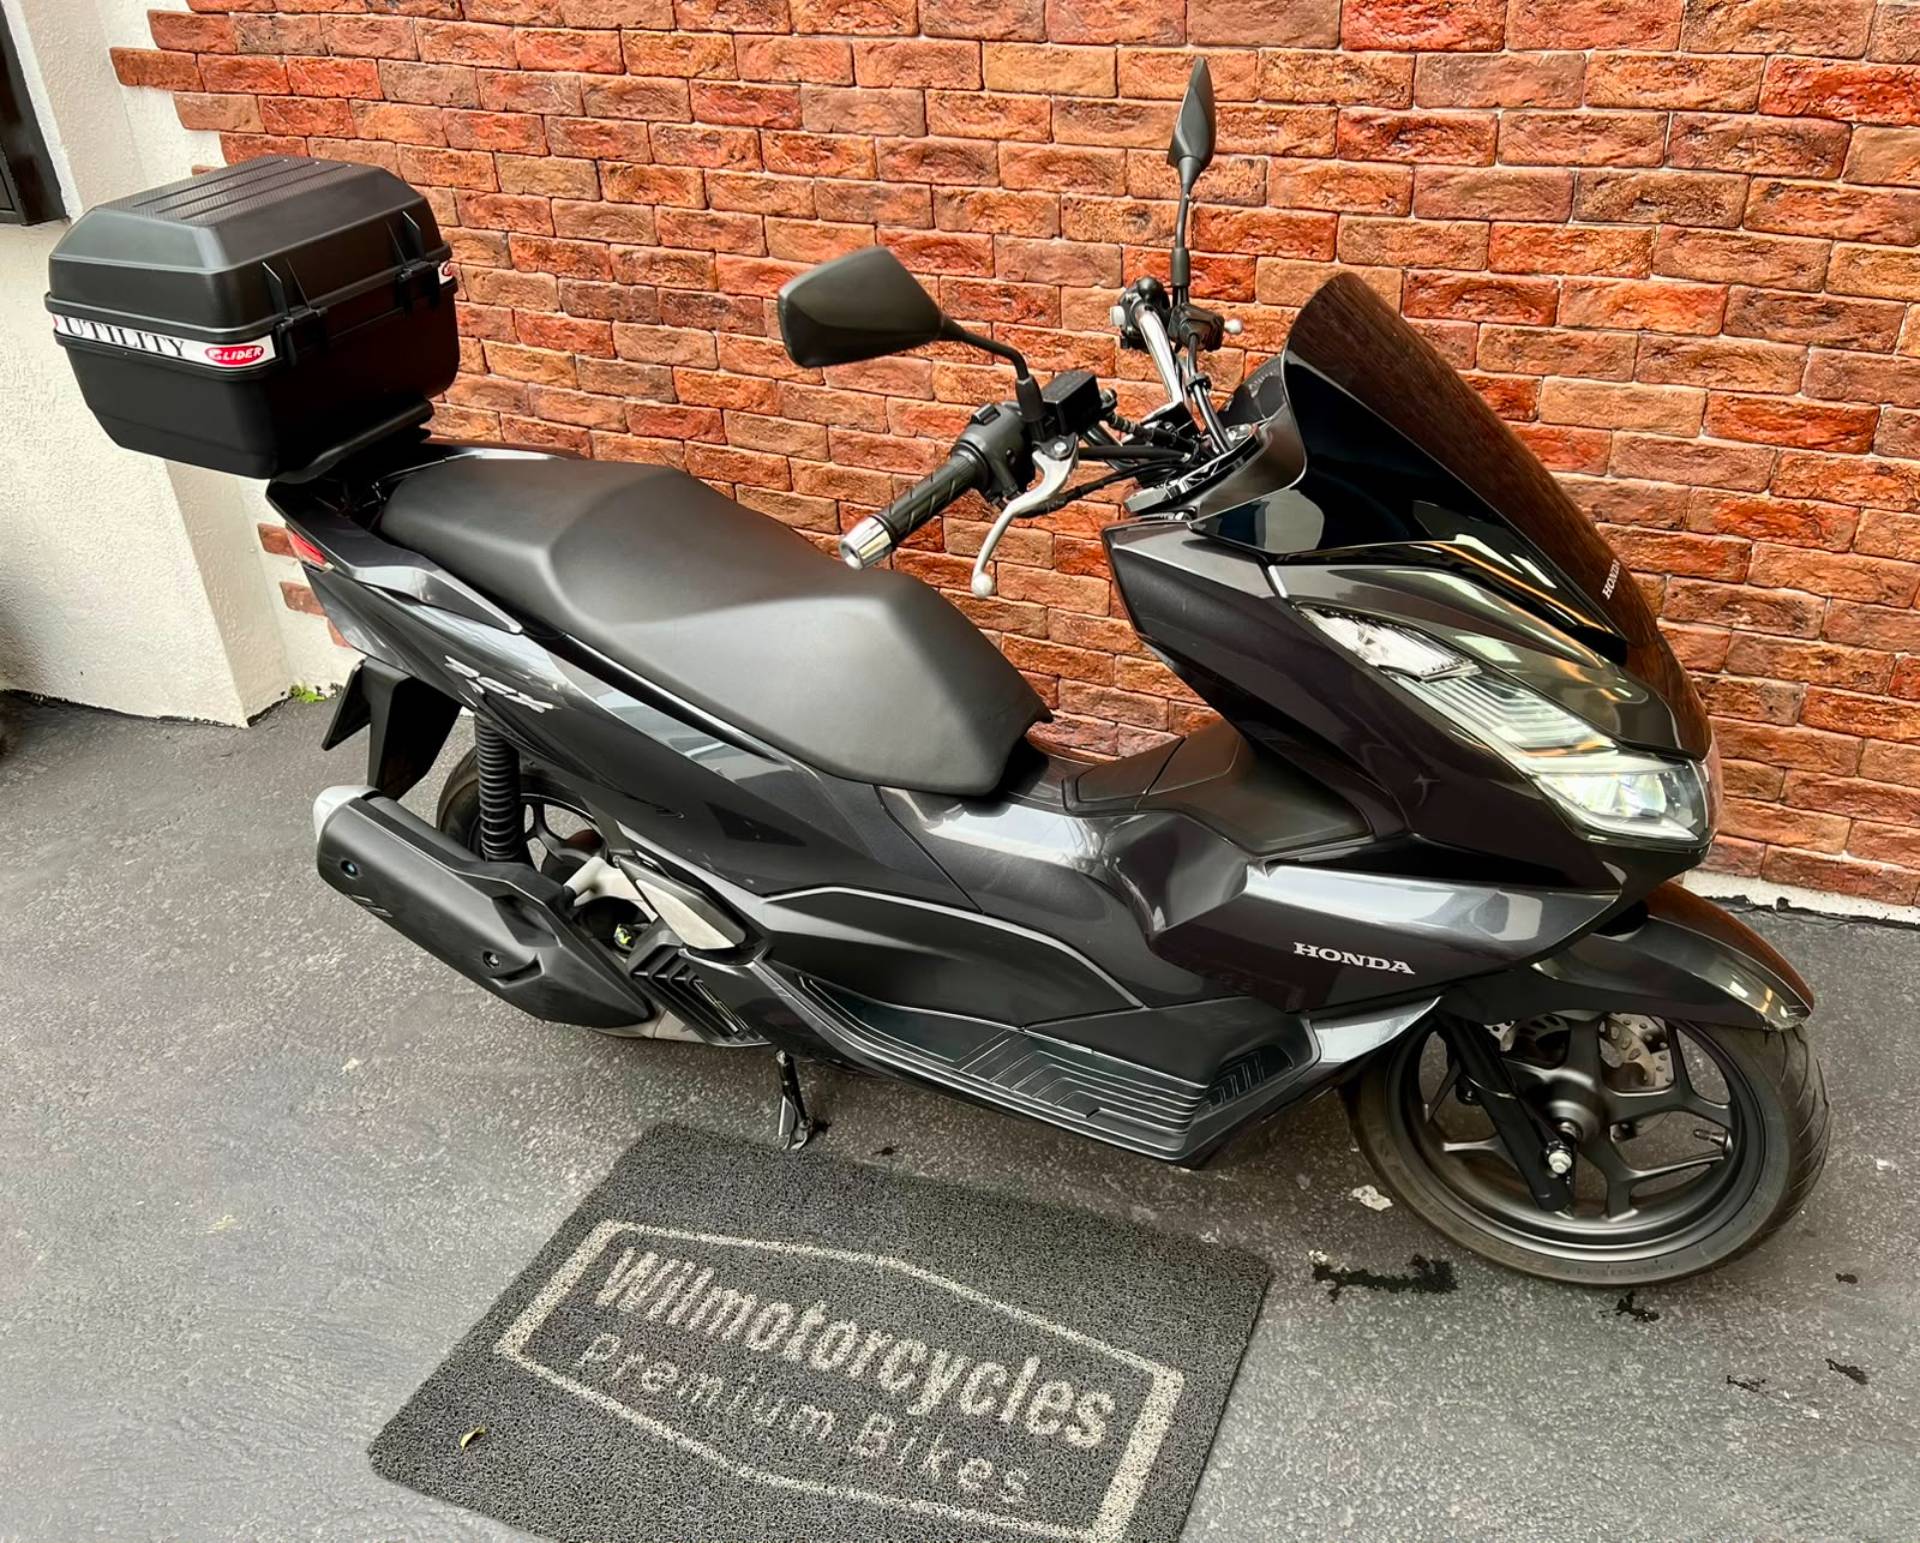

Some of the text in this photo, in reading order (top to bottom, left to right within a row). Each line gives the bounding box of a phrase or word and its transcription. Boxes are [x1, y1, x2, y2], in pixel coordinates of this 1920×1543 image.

[64, 317, 185, 357] UTILITY
[207, 345, 263, 361] GLIDER
[1293, 941, 1416, 975] HONDA
[595, 1247, 1115, 1448] Wilmotorcycles
[575, 1332, 1029, 1503] Premium Bikes
